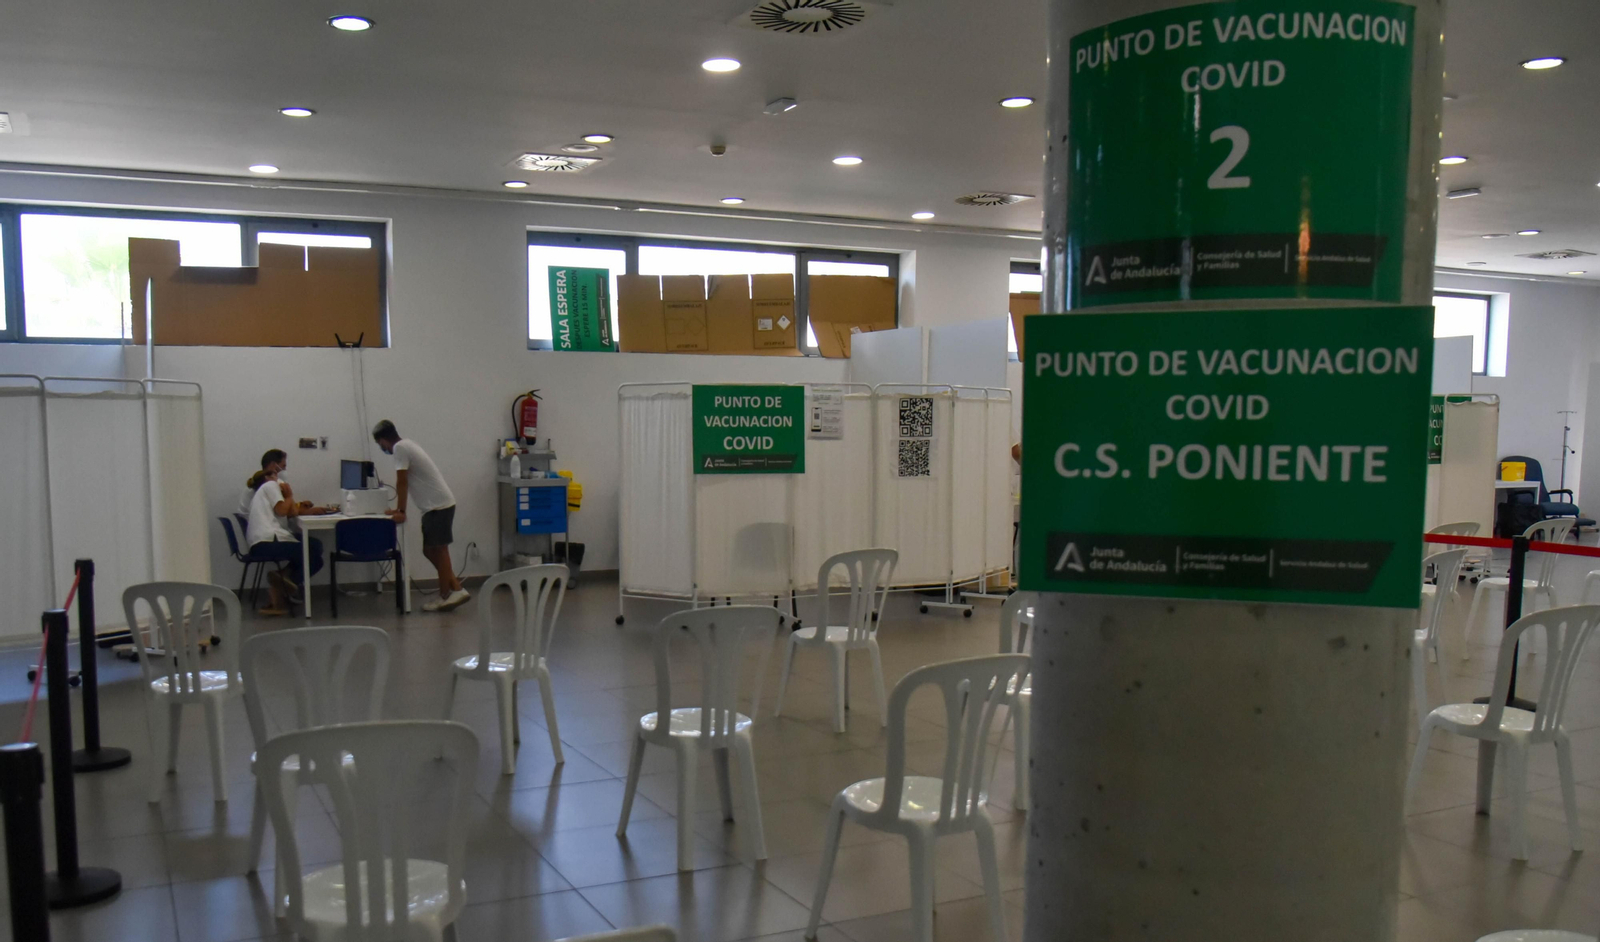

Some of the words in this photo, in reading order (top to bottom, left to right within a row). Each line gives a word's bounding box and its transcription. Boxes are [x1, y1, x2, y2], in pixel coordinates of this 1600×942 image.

[1076, 29, 1155, 73] PUNTO
[1164, 20, 1203, 51] DE
[1212, 12, 1406, 46] VACUNACION
[1181, 60, 1286, 93] COVID
[1207, 125, 1251, 189] 2
[1110, 268, 1122, 280] de
[1124, 263, 1181, 279] Andalucía
[1111, 255, 1140, 267] Junta
[556, 269, 568, 316] ESPERA
[571, 269, 579, 318] VACUNACION
[559, 319, 571, 349] SALA
[573, 320, 583, 350] DESPUES
[582, 314, 590, 338] ESPERE
[1035, 351, 1139, 377] PUNTO
[1148, 350, 1188, 376] DE
[1197, 348, 1419, 375] VACUNACION
[714, 396, 761, 408] PUNTO
[765, 396, 782, 408] DE
[1165, 394, 1269, 420] COVID
[704, 415, 793, 428] VACUNACION
[723, 436, 774, 450] COVID
[1053, 443, 1131, 478] C.S.
[1148, 444, 1389, 483] PONIENTE
[1089, 559, 1104, 570] de
[1106, 560, 1168, 572] Andalucía
[1090, 547, 1124, 558] Junta
